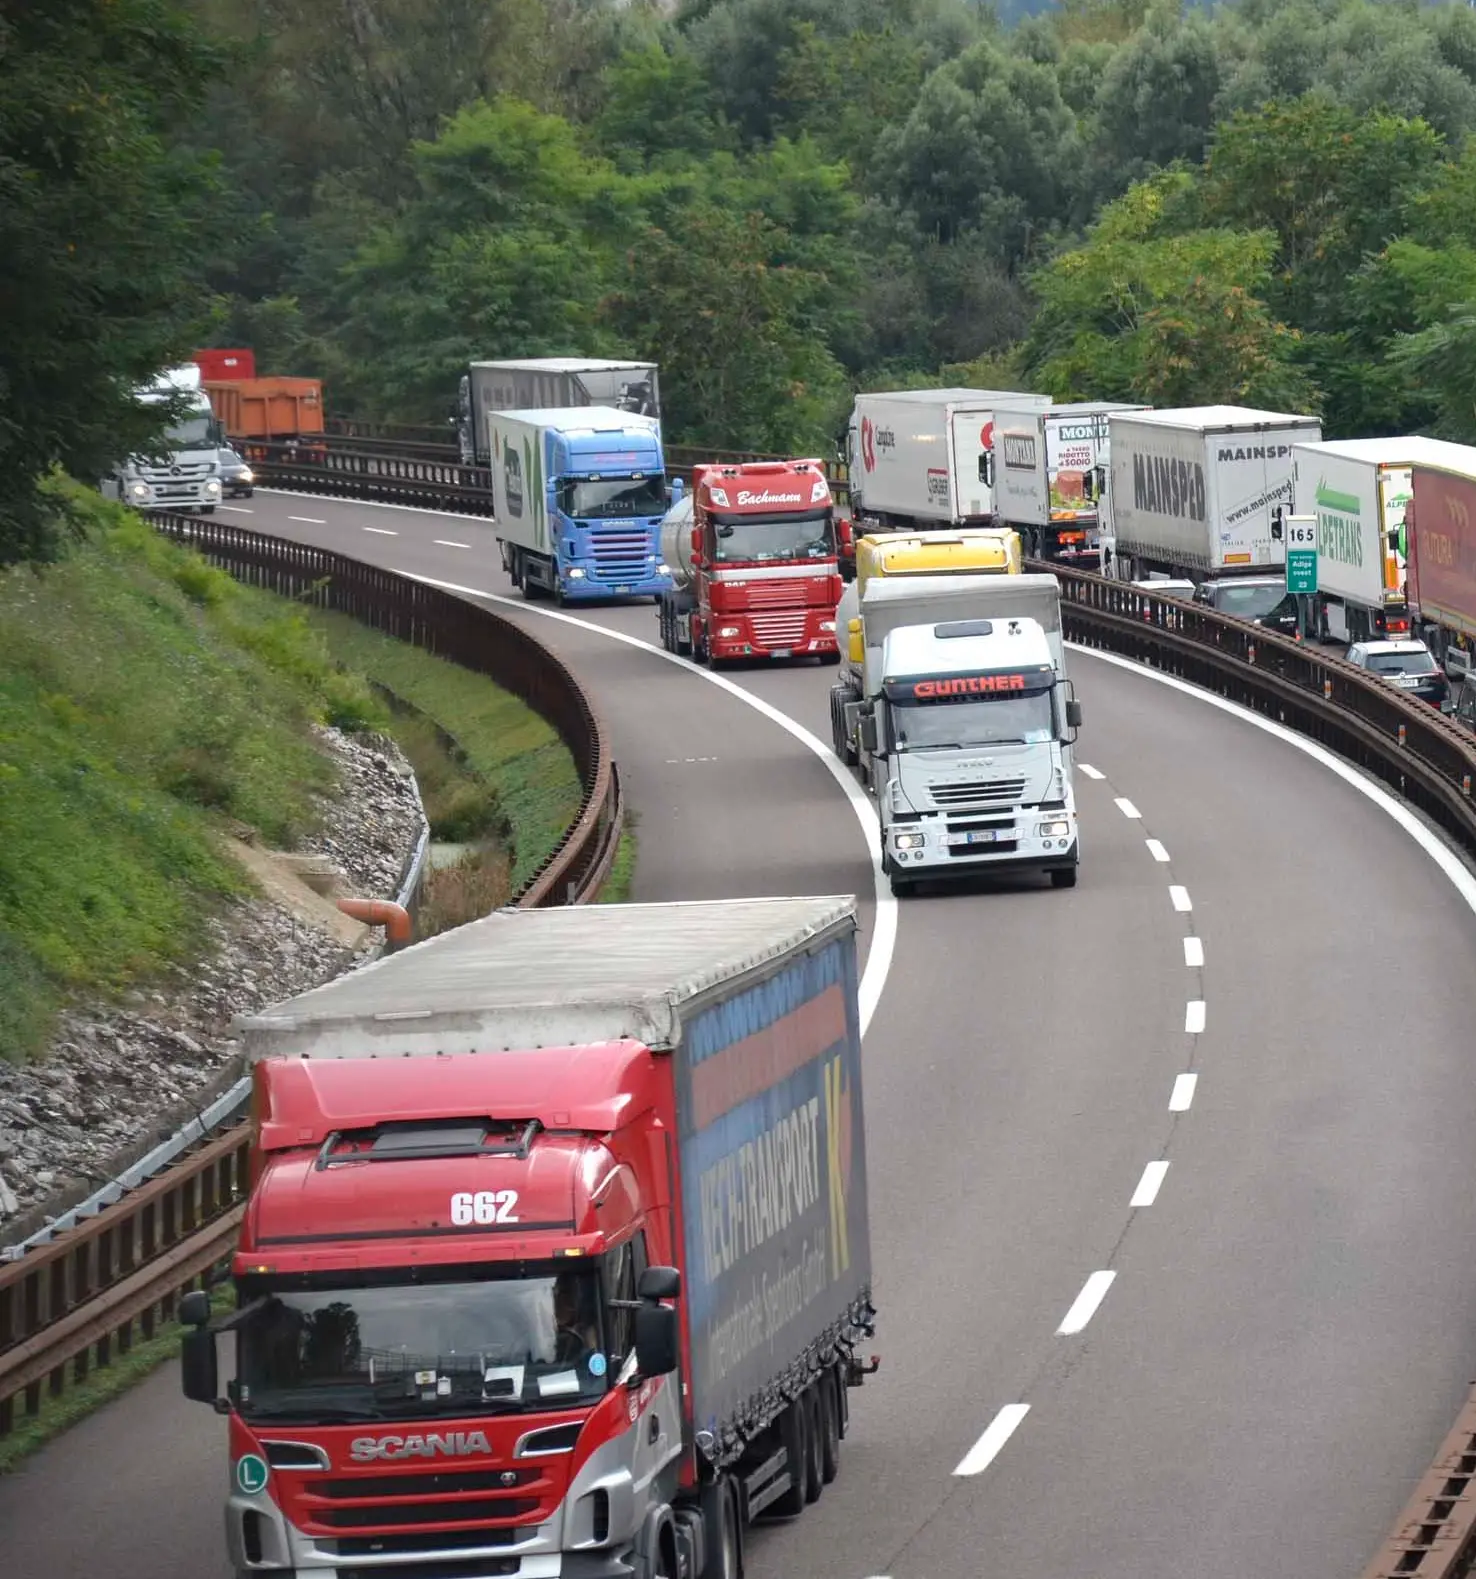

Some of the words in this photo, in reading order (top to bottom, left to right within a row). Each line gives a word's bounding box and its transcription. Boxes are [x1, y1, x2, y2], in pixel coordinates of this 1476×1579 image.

[736, 489, 802, 505] Bachmann
[1290, 528, 1314, 542] 165
[1313, 511, 1363, 568] LPETRANS
[449, 1188, 520, 1226] 662
[349, 1430, 492, 1462] SCANIA
